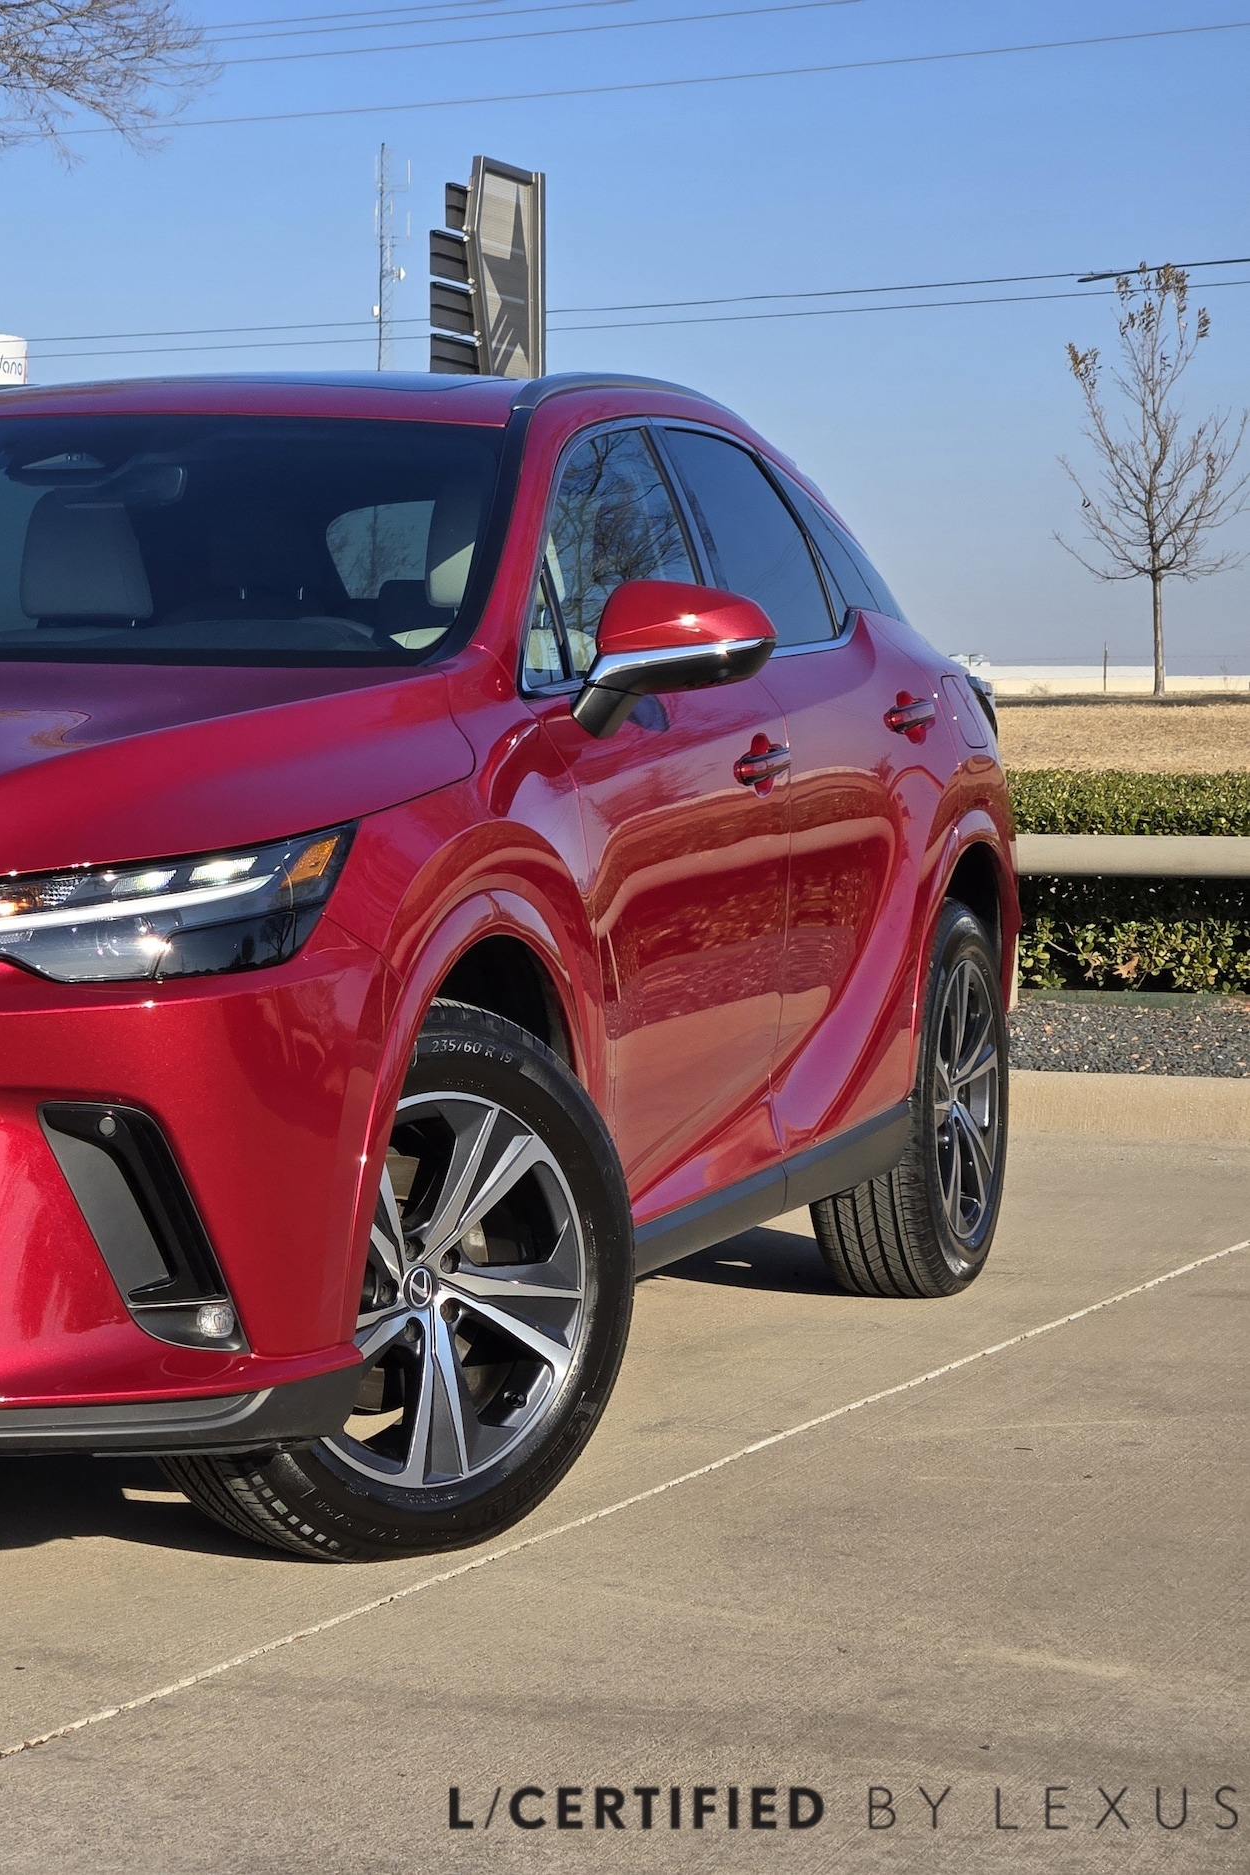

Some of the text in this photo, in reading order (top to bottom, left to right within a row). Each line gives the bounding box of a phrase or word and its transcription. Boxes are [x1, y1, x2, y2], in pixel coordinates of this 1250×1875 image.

[431, 1038, 483, 1055] 235/60
[484, 1045, 496, 1059] R
[499, 1048, 514, 1064] 19
